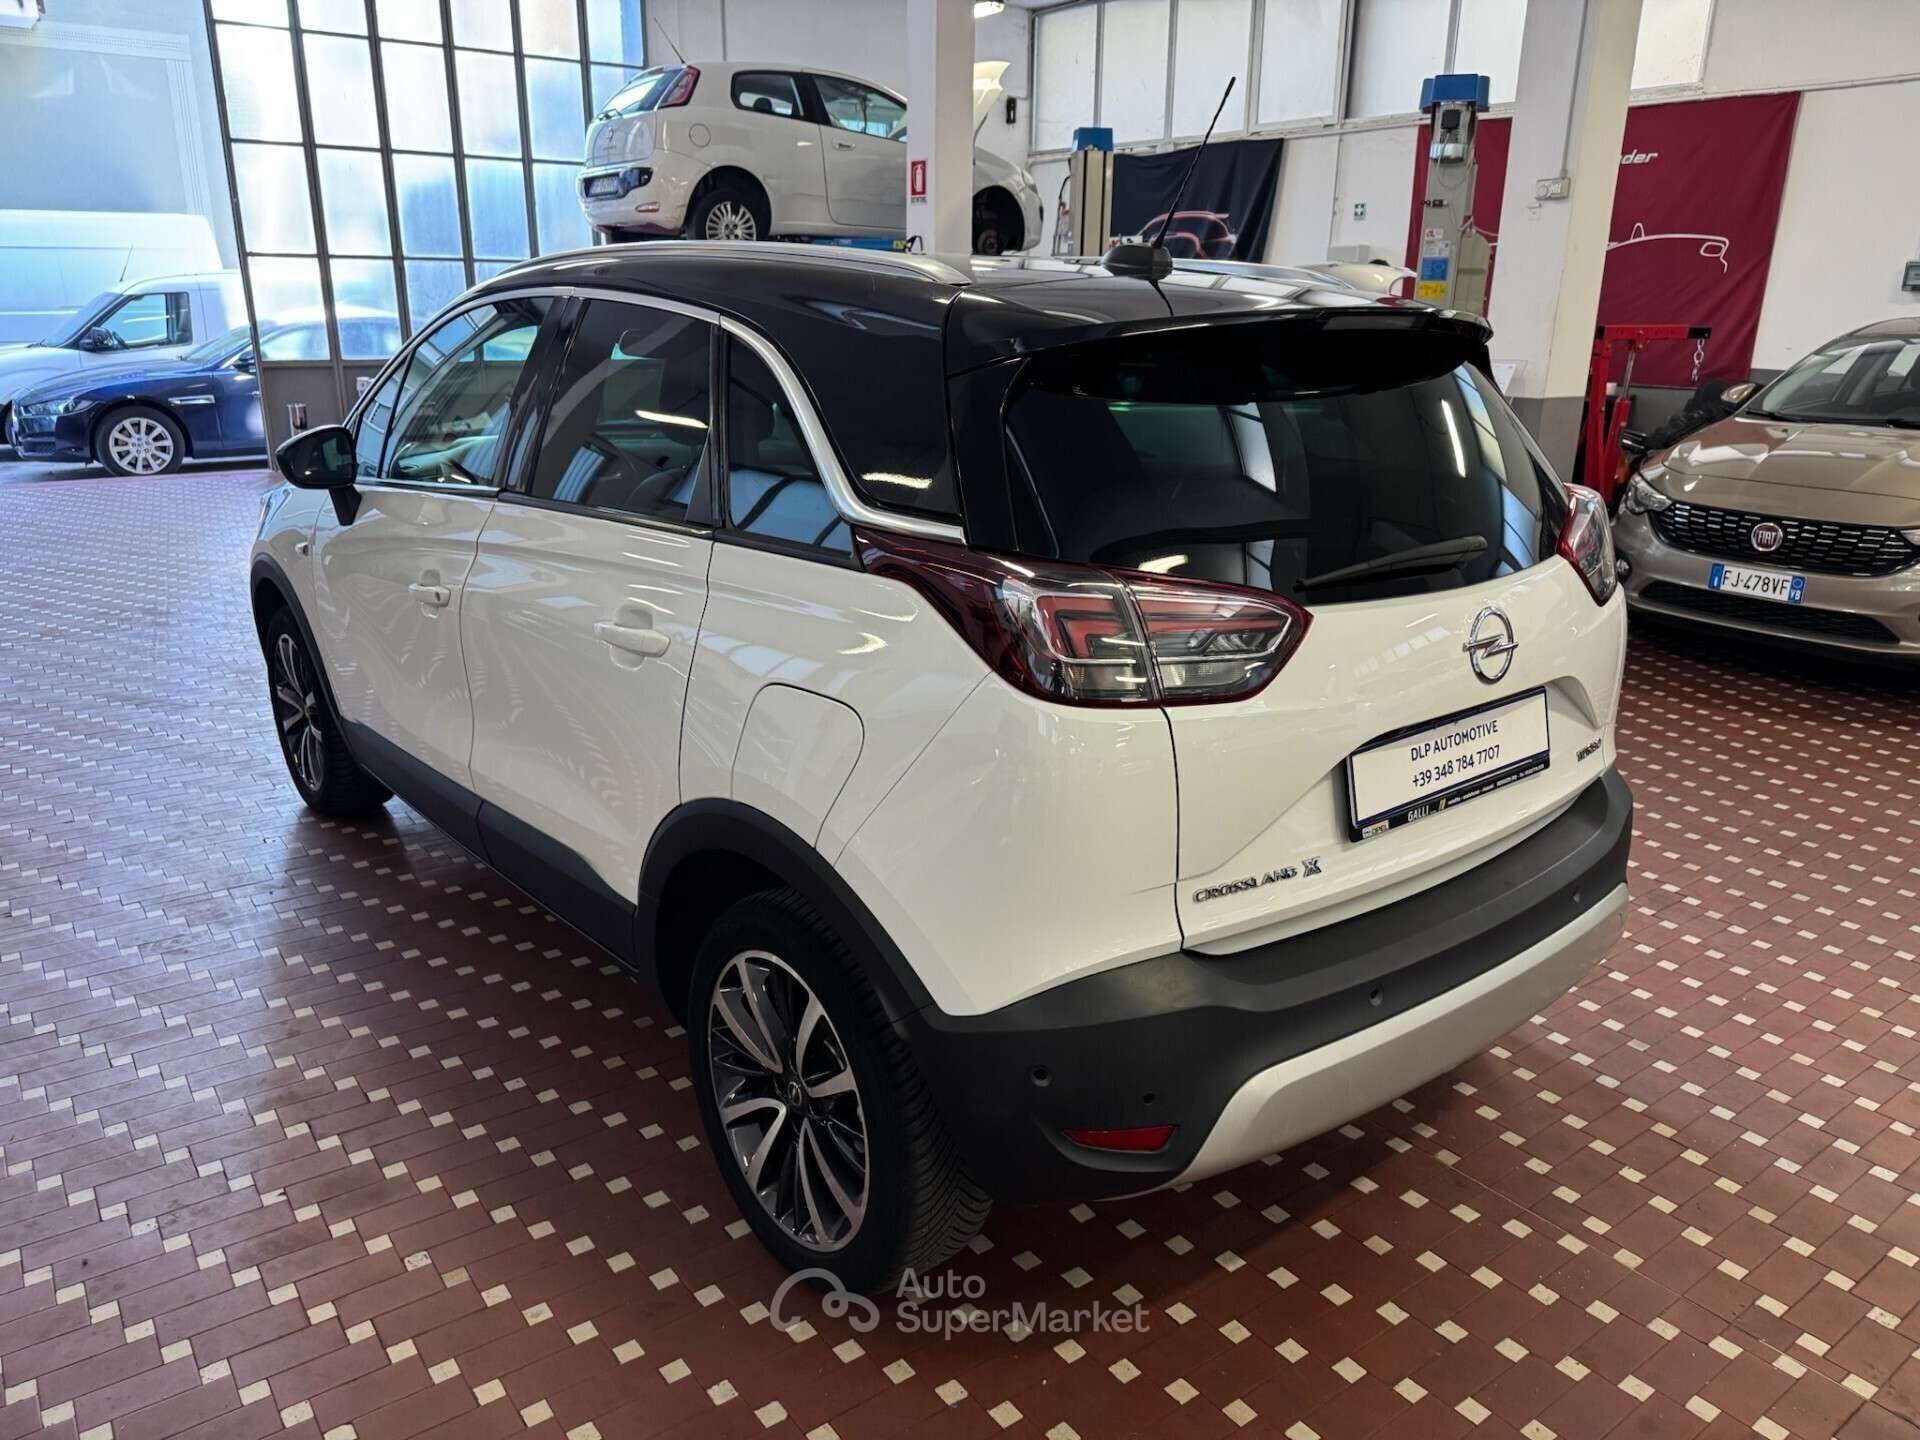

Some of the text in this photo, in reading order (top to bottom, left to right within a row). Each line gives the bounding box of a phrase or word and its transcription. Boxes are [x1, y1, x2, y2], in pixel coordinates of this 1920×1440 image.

[1620, 149, 1659, 165] der
[1757, 530, 1777, 545] FIAT
[1411, 719, 1499, 762] DLP AUTOMOTIVE
[1412, 744, 1500, 787] +39 348 784 7707
[1407, 804, 1430, 822] GALLI
[1301, 856, 1322, 878] X
